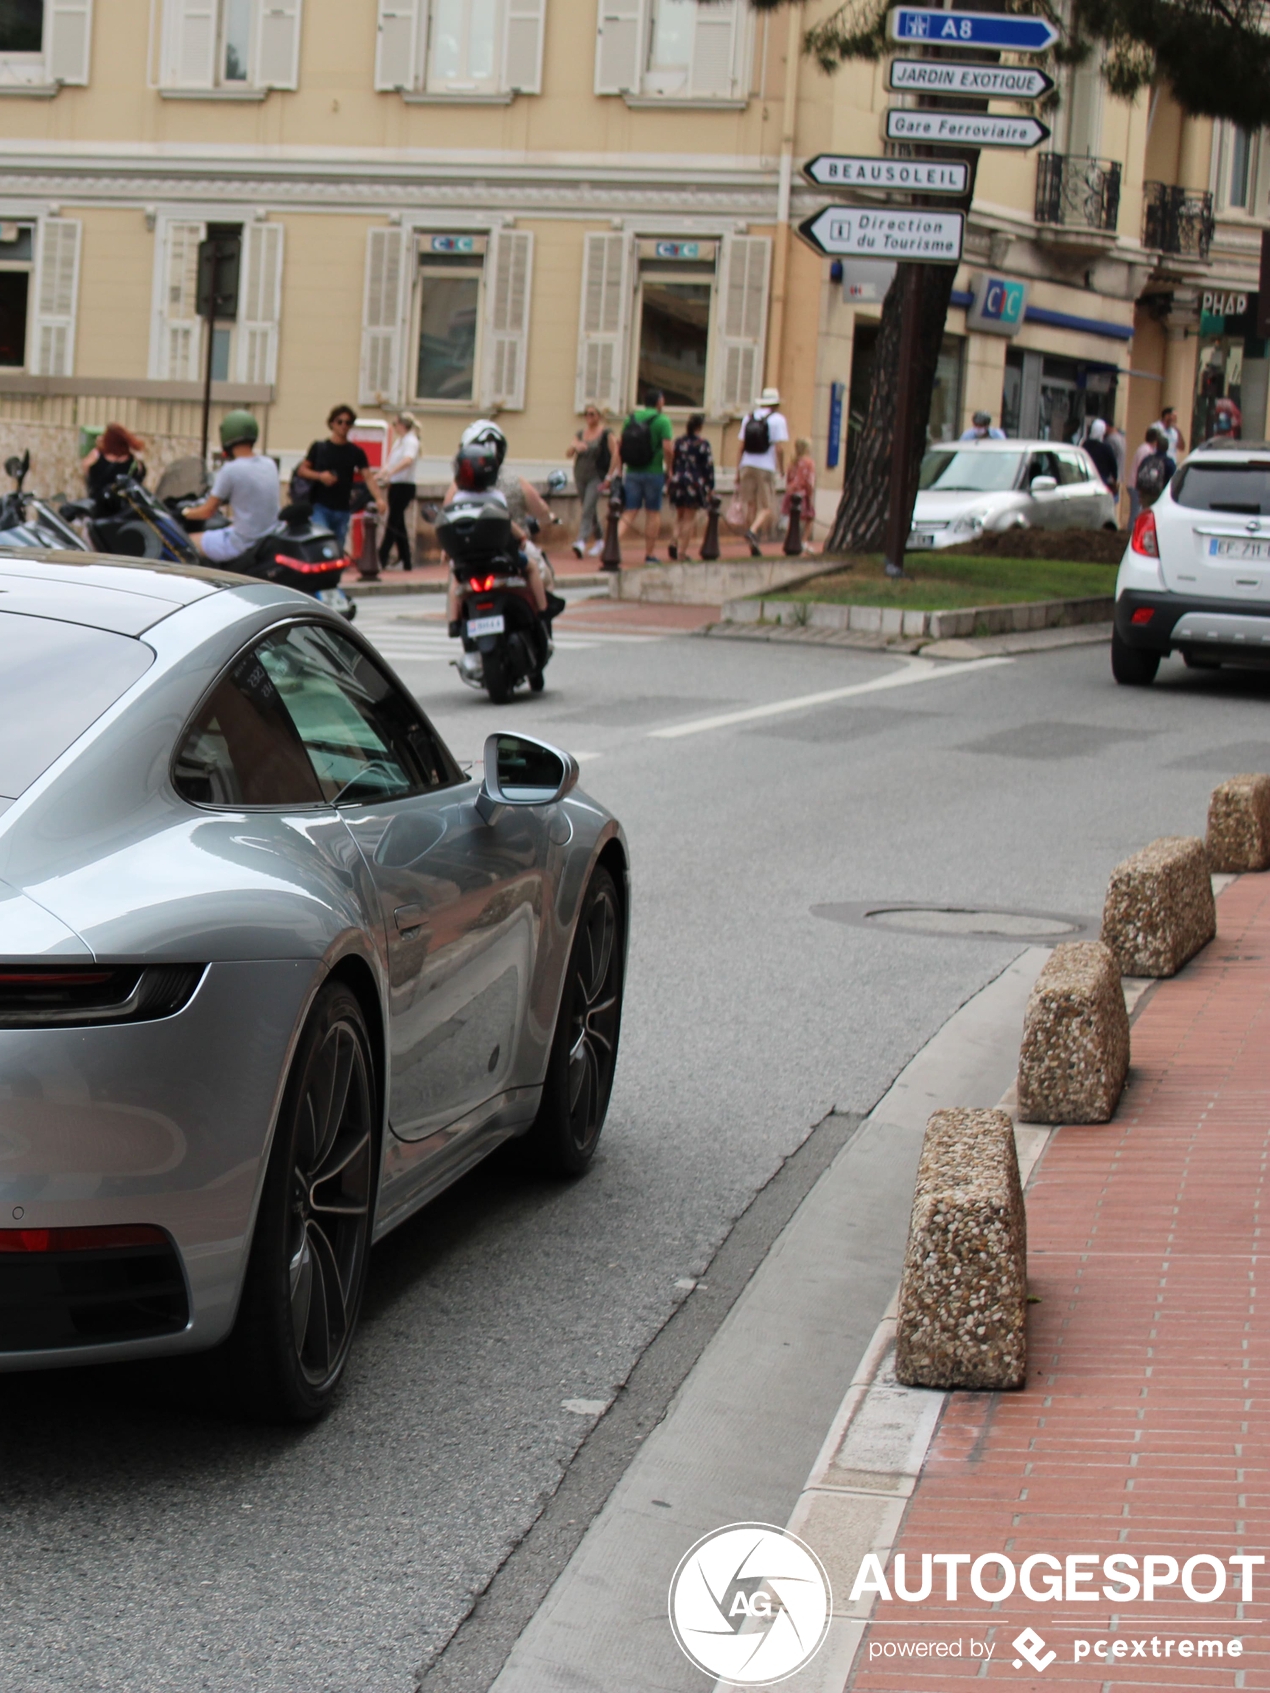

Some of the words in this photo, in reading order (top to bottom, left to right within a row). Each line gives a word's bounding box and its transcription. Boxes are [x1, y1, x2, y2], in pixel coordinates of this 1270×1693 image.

[941, 18, 972, 39] A8
[897, 67, 955, 85] JARDIN
[960, 70, 1036, 91] EXOTIQUE
[895, 117, 931, 133] Gare
[938, 120, 1028, 140] Ferroviaire
[829, 163, 958, 185] BEAUSOLEIL
[858, 214, 943, 234] Direction
[857, 234, 875, 248] du
[883, 234, 954, 252] Tourisme
[987, 286, 1020, 316] CIC
